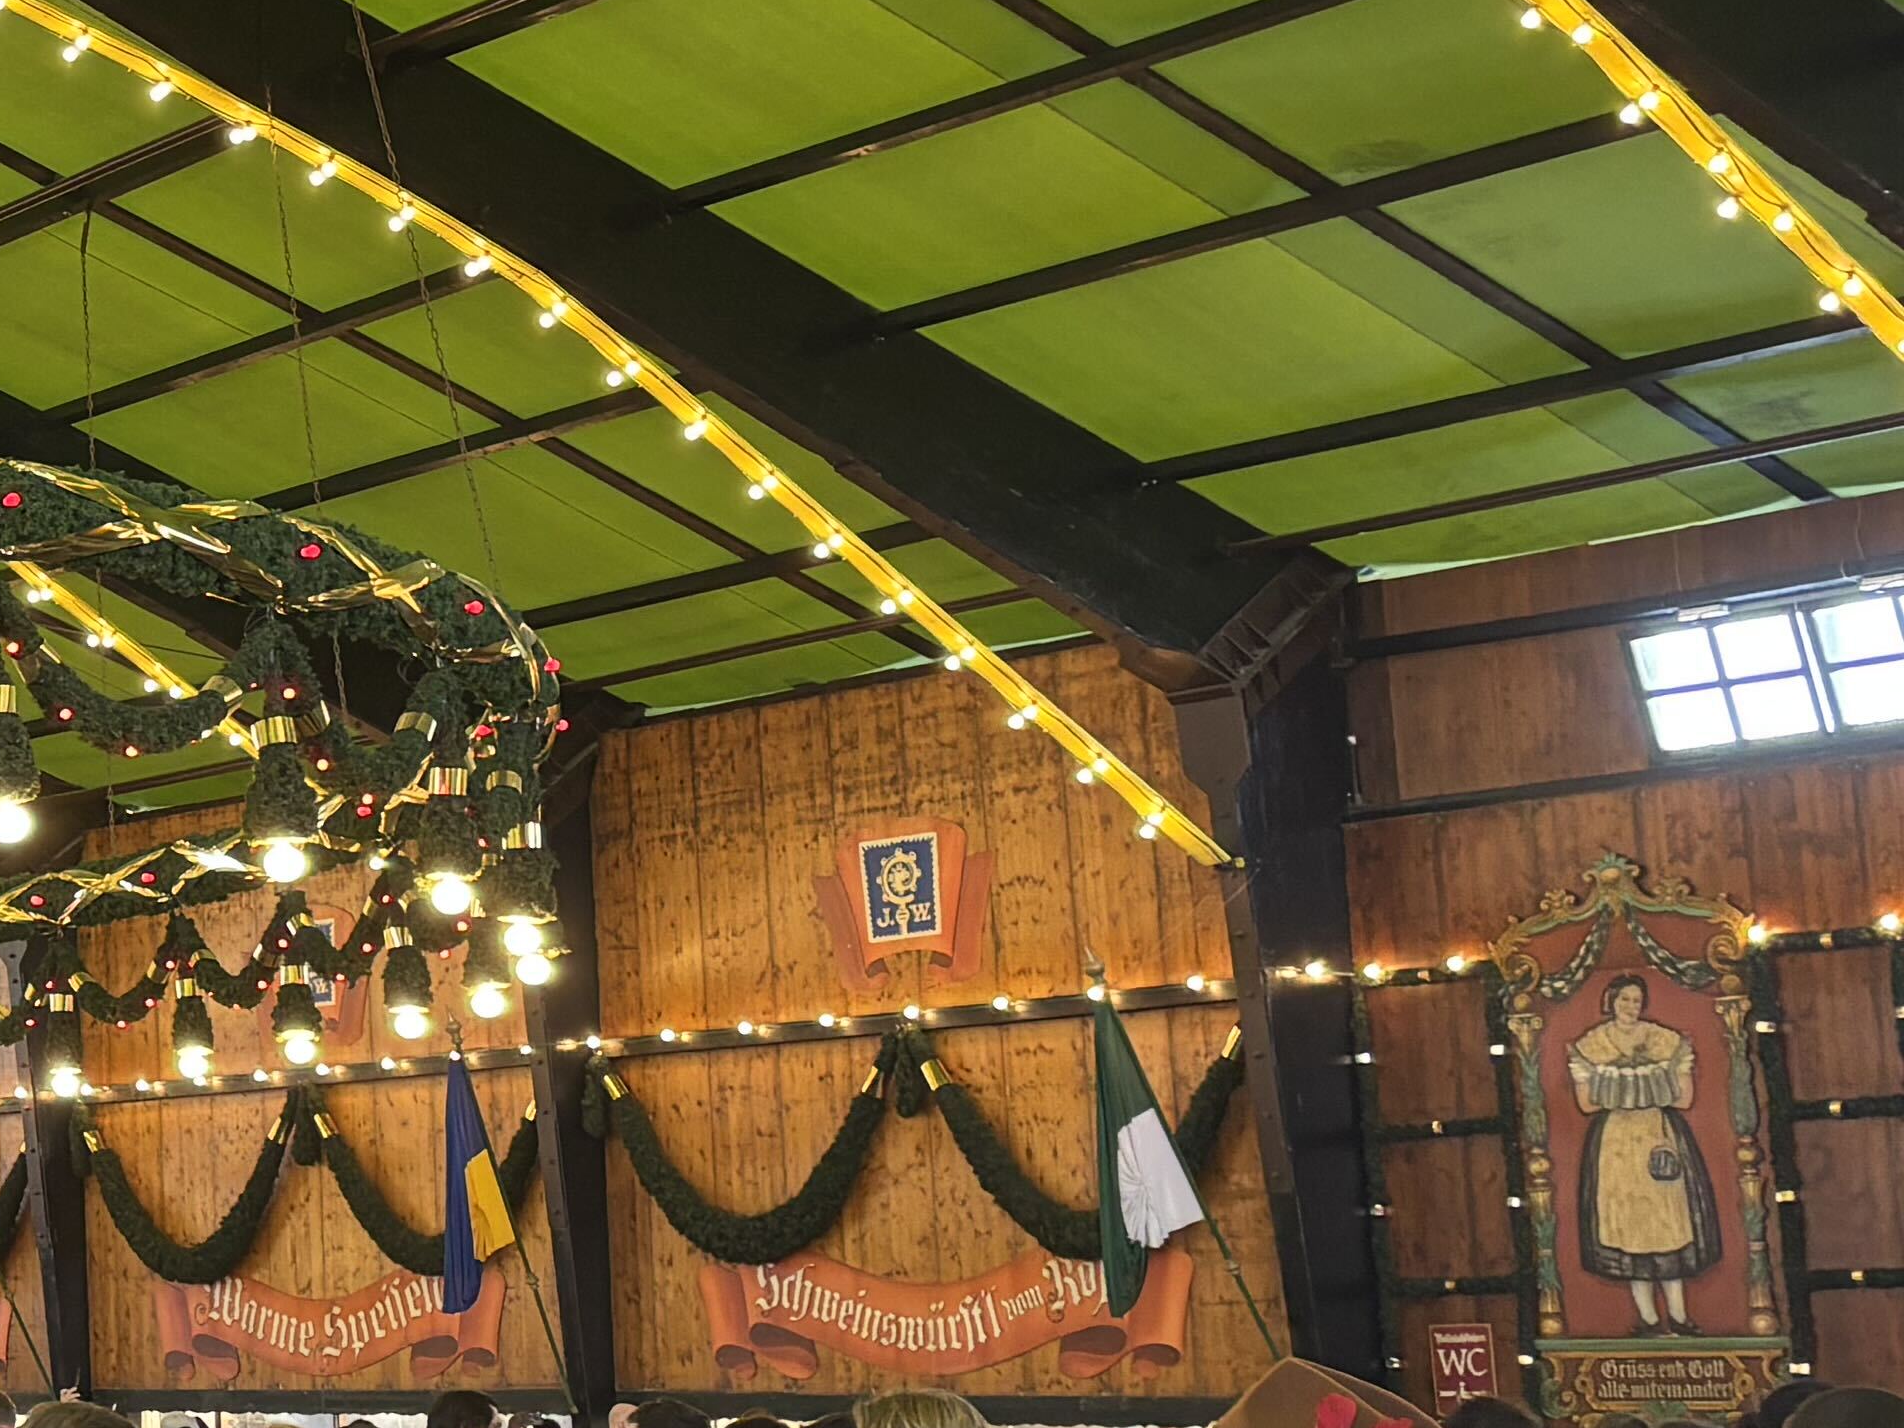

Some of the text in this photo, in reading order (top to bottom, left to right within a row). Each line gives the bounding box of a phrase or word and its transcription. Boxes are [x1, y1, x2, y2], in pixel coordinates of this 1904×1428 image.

[876, 907, 895, 928] J.
[205, 1275, 316, 1357] Warme
[1000, 1284, 1044, 1321] vom
[1436, 1347, 1488, 1377] WC
